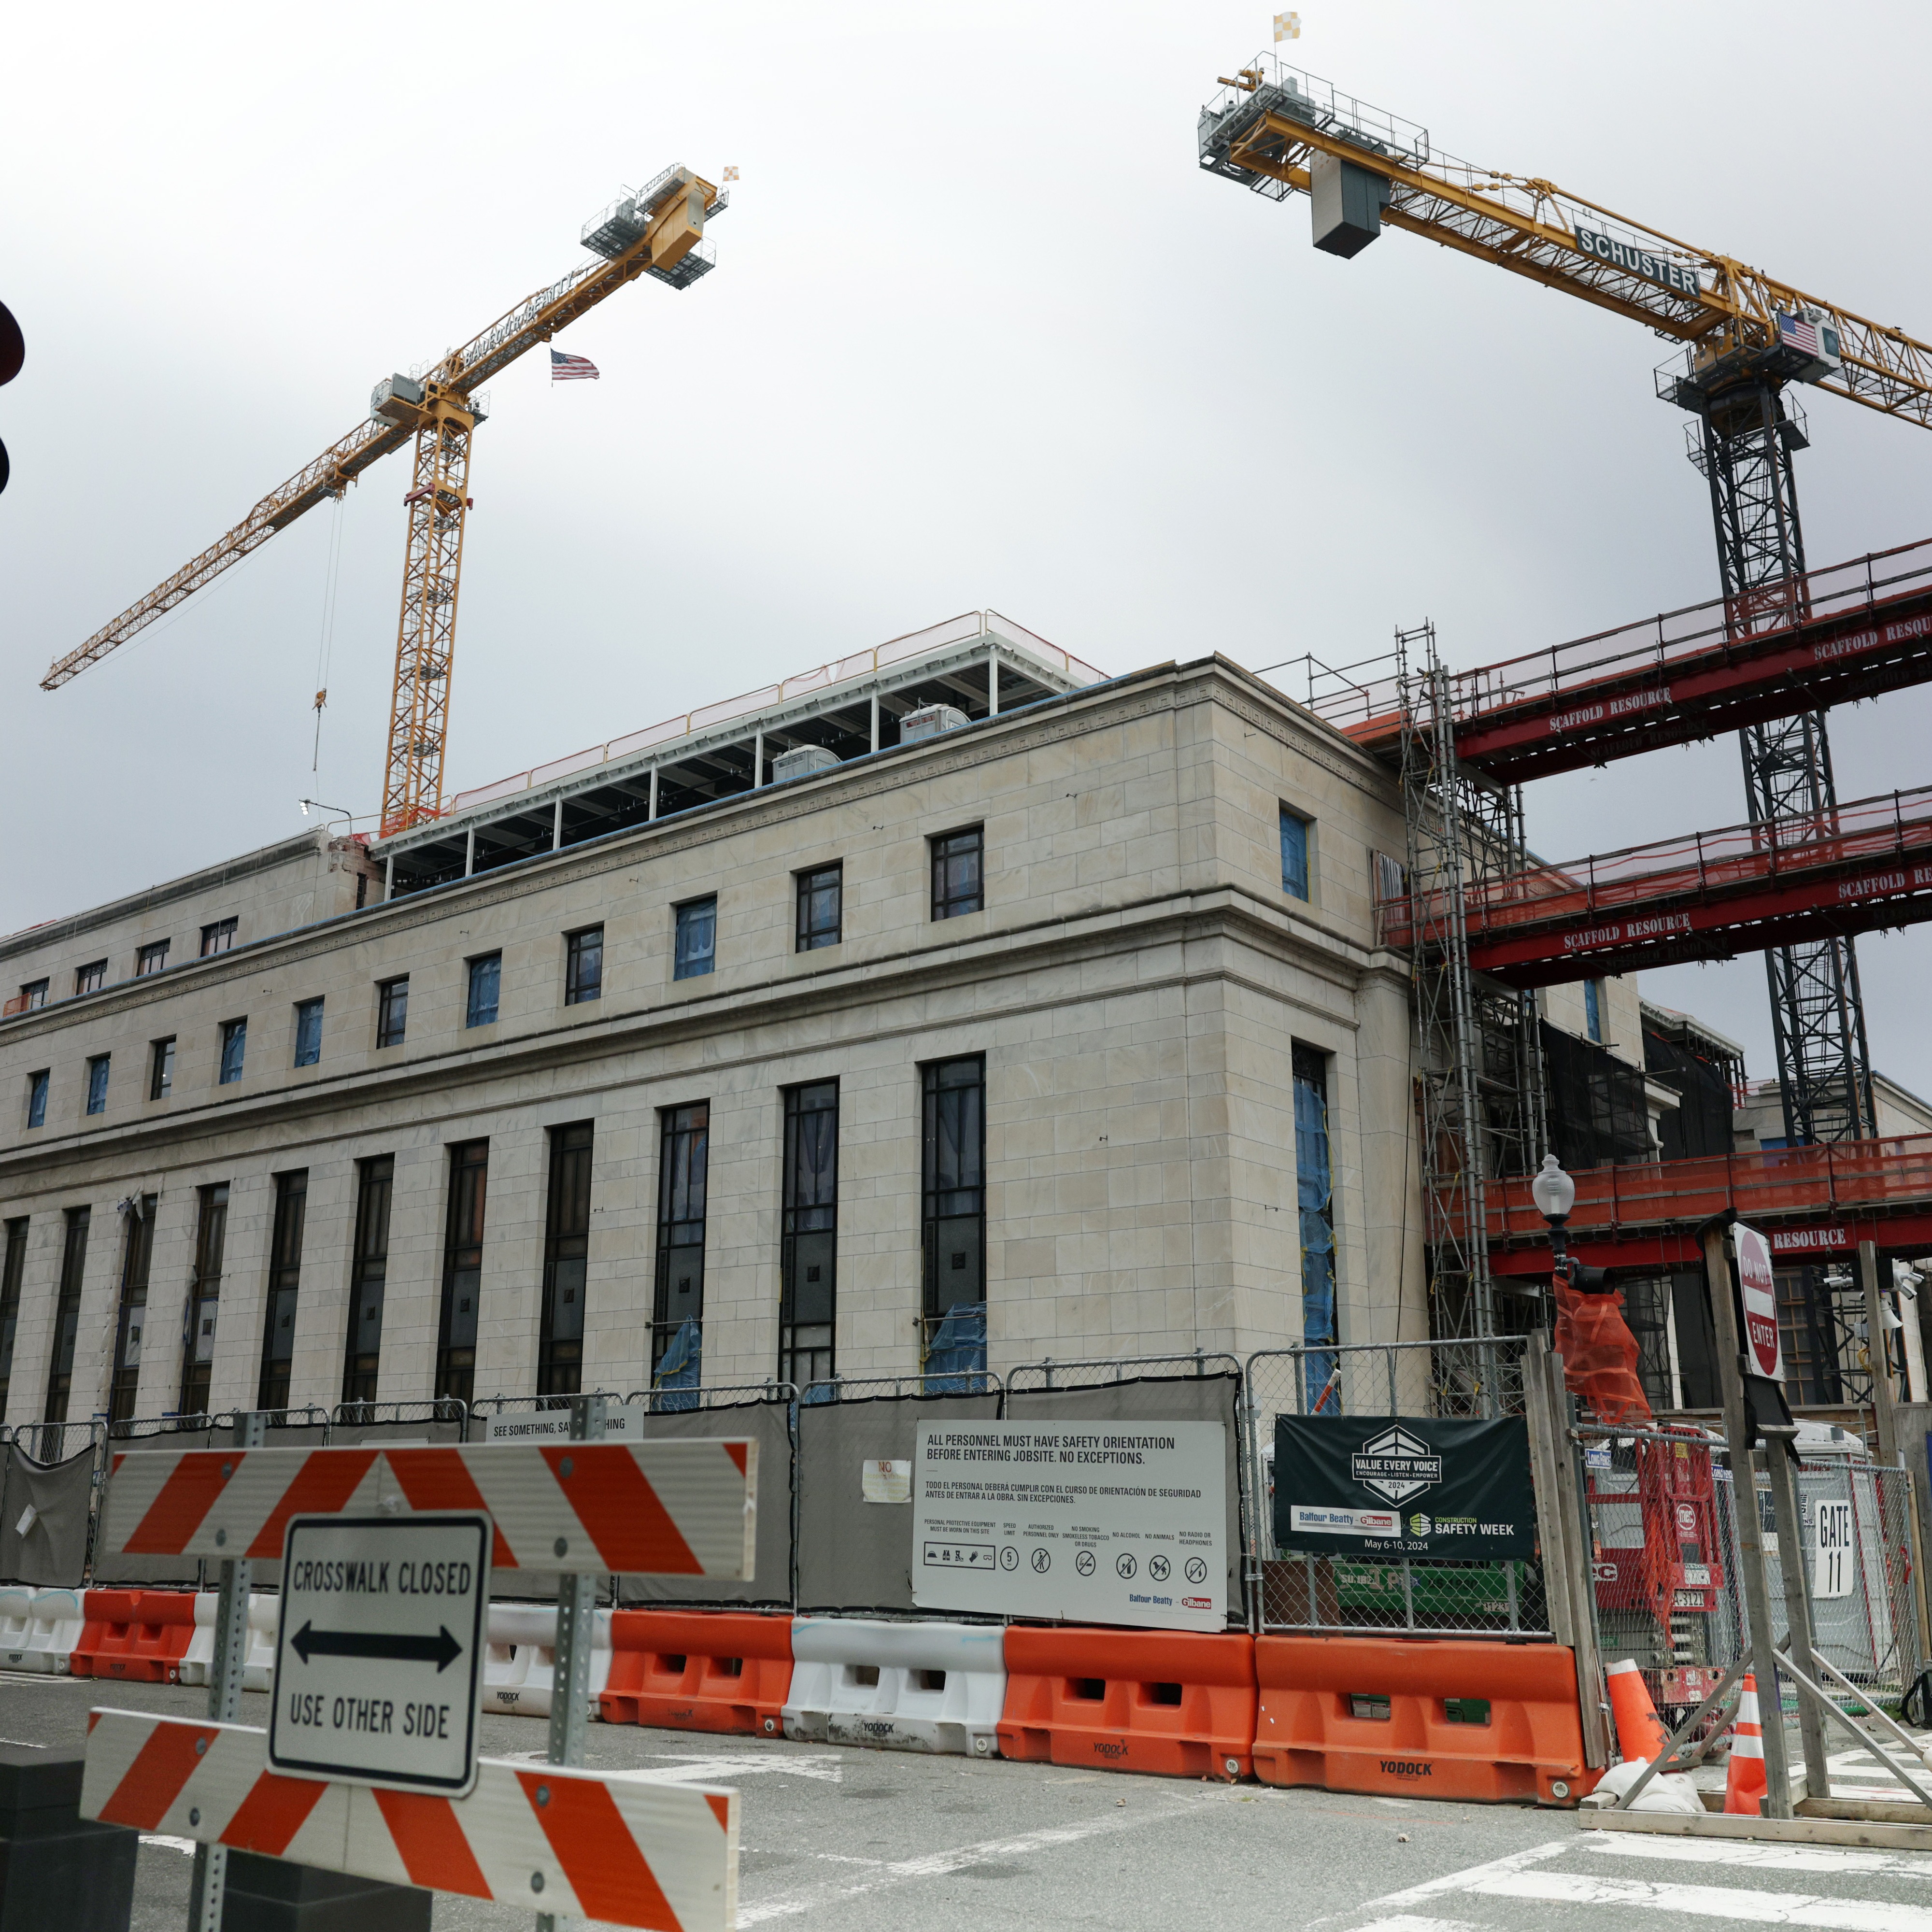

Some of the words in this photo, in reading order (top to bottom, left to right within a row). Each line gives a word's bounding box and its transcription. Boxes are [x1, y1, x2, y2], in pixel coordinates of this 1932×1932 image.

[1580, 229, 1697, 295] SCHUSTER
[464, 314, 521, 367] BALFOUR
[526, 270, 575, 321] BEATTY
[1814, 631, 1878, 661] SCAFFOLD
[1886, 615, 1932, 641] RESOU
[1549, 705, 1604, 731] SCAFFOLD
[1610, 687, 1671, 715] RESOURCE
[1838, 873, 1905, 899] SCAFFOLD
[1564, 926, 1620, 949] SCAFFOLD
[1626, 912, 1690, 938] RESOURCE
[1773, 1228, 1846, 1249] RESOURCE
[1743, 1256, 1753, 1279] DO
[1754, 1261, 1768, 1285] NOT
[1752, 1321, 1775, 1349] ENTER
[494, 1425, 507, 1437] SEE
[509, 1422, 556, 1436] SOMETHING,
[927, 1435, 943, 1446] ALL
[946, 1435, 1001, 1447] PERSONNEL
[1003, 1435, 1032, 1447] MUST
[1034, 1436, 1060, 1448] HAVE
[1062, 1436, 1100, 1448] SAFETY
[1103, 1436, 1175, 1449] ORIENTATION
[927, 1449, 961, 1460] BEFORE
[964, 1449, 1010, 1462] ENTERING
[1013, 1450, 1057, 1463] JOBSITE.
[1059, 1451, 1074, 1463] NO
[1077, 1451, 1145, 1464] EXCEPTIONS.
[878, 1461, 892, 1473] NO
[1355, 1459, 1382, 1470] VALUE
[1384, 1460, 1411, 1471] EVERY
[1413, 1461, 1438, 1472] VOICE
[925, 1491, 945, 1499] ANTES
[956, 1492, 980, 1500] ENTRAR
[996, 1493, 1016, 1501] OBRA.
[1017, 1493, 1028, 1502] SIN
[1030, 1494, 1076, 1504] EXCEPCIONES.
[926, 1481, 942, 1489] TODO
[952, 1482, 983, 1491] PERSONAL
[985, 1481, 1009, 1492] DEBERÁ
[1011, 1484, 1039, 1492] CUMPLIR
[1040, 1485, 1054, 1493] CON
[1056, 1485, 1063, 1493] EL
[1065, 1485, 1087, 1494] CURSO
[1089, 1486, 1097, 1494] DE
[1099, 1486, 1146, 1496] ORIENTACIÓN
[1148, 1488, 1157, 1496] DE
[1159, 1489, 1201, 1498] SEGURIDAD
[1299, 1511, 1327, 1522] Balfour
[1329, 1513, 1353, 1525] Beatty
[1360, 1516, 1392, 1526] Gilbane
[1820, 1505, 1849, 1548] GATE
[1435, 1523, 1477, 1534] SAFETY
[1479, 1524, 1515, 1535] WEEK
[1365, 1539, 1382, 1551] May
[1384, 1541, 1405, 1551] 6-10,
[1407, 1541, 1429, 1550] 2024
[1007, 1552, 1012, 1562] 5
[294, 1561, 390, 1593] CROSSWALK
[398, 1562, 472, 1595] CLOSED
[1829, 1551, 1841, 1593] 11
[1129, 1594, 1151, 1604] Balfour
[1153, 1596, 1173, 1605] Beatty
[1181, 1597, 1211, 1608] Gilbane
[497, 1691, 520, 1701] YODOCK
[291, 1693, 324, 1728] USE
[333, 1697, 394, 1734] OTHER
[403, 1704, 450, 1739] SIDE
[864, 1722, 895, 1733] YODOCK
[1380, 1761, 1432, 1776] YODOCK
